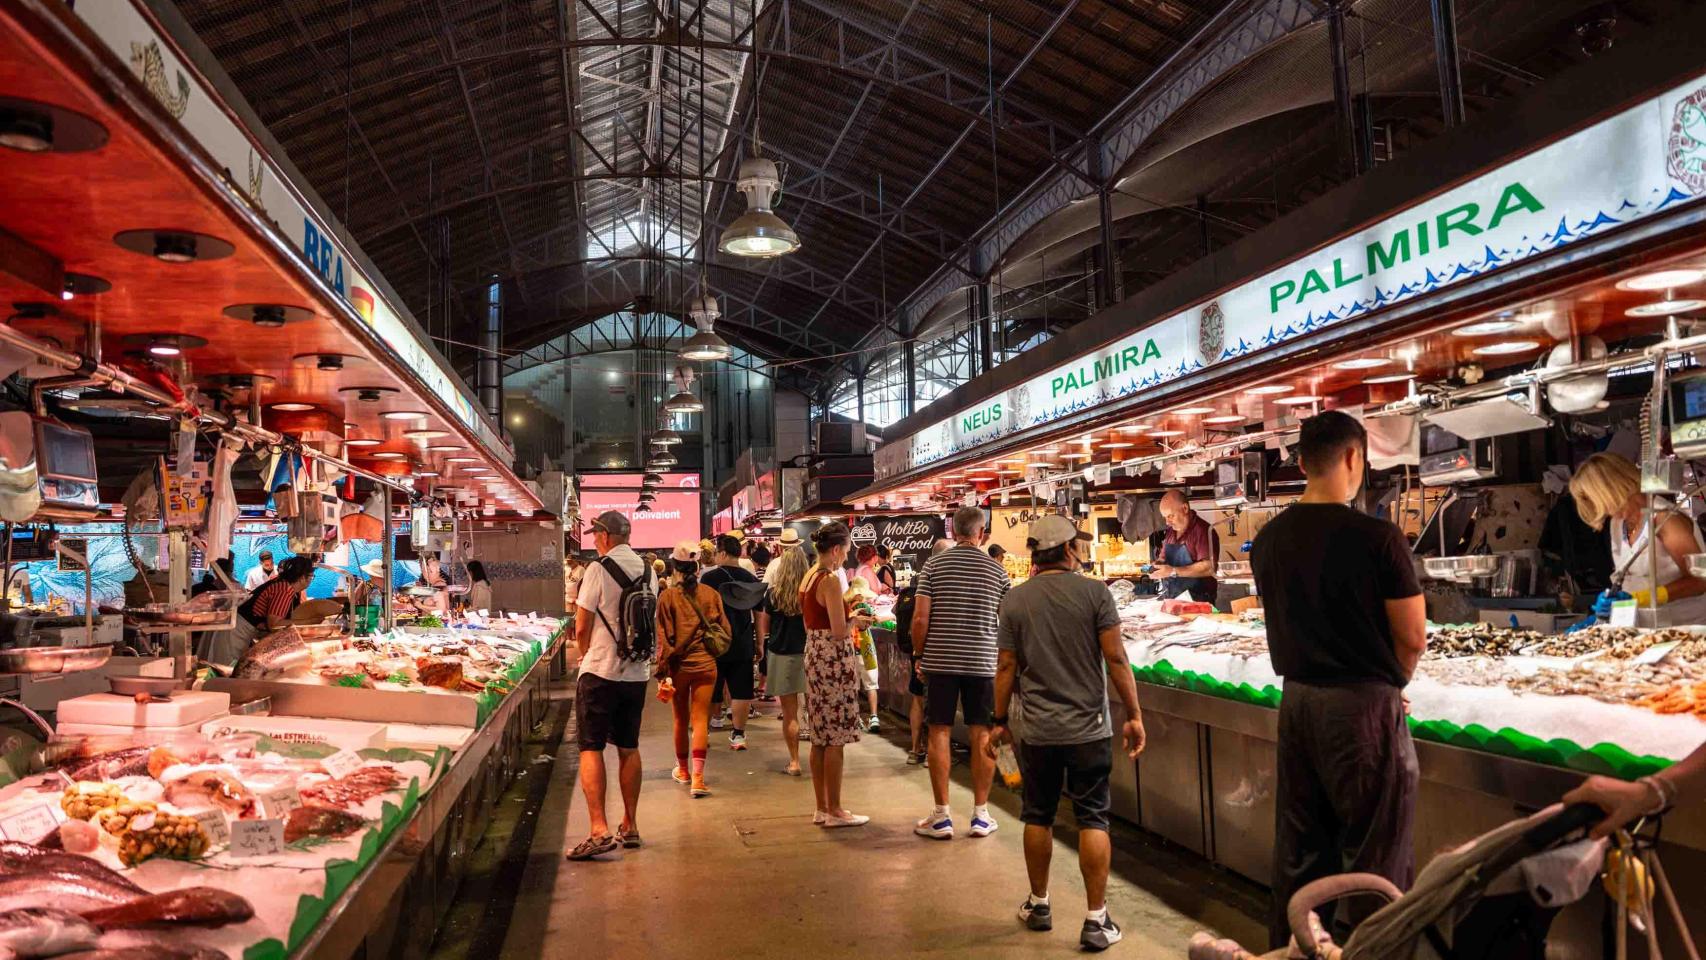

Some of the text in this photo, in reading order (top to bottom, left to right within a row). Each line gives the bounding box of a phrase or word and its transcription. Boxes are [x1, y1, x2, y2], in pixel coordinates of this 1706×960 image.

[1269, 182, 1545, 313] PALMIRA
[1052, 338, 1162, 398] PALMIRA
[963, 403, 1002, 434] NEUS
[881, 535, 935, 550] SeaFood
[882, 520, 930, 536] MoltBo
